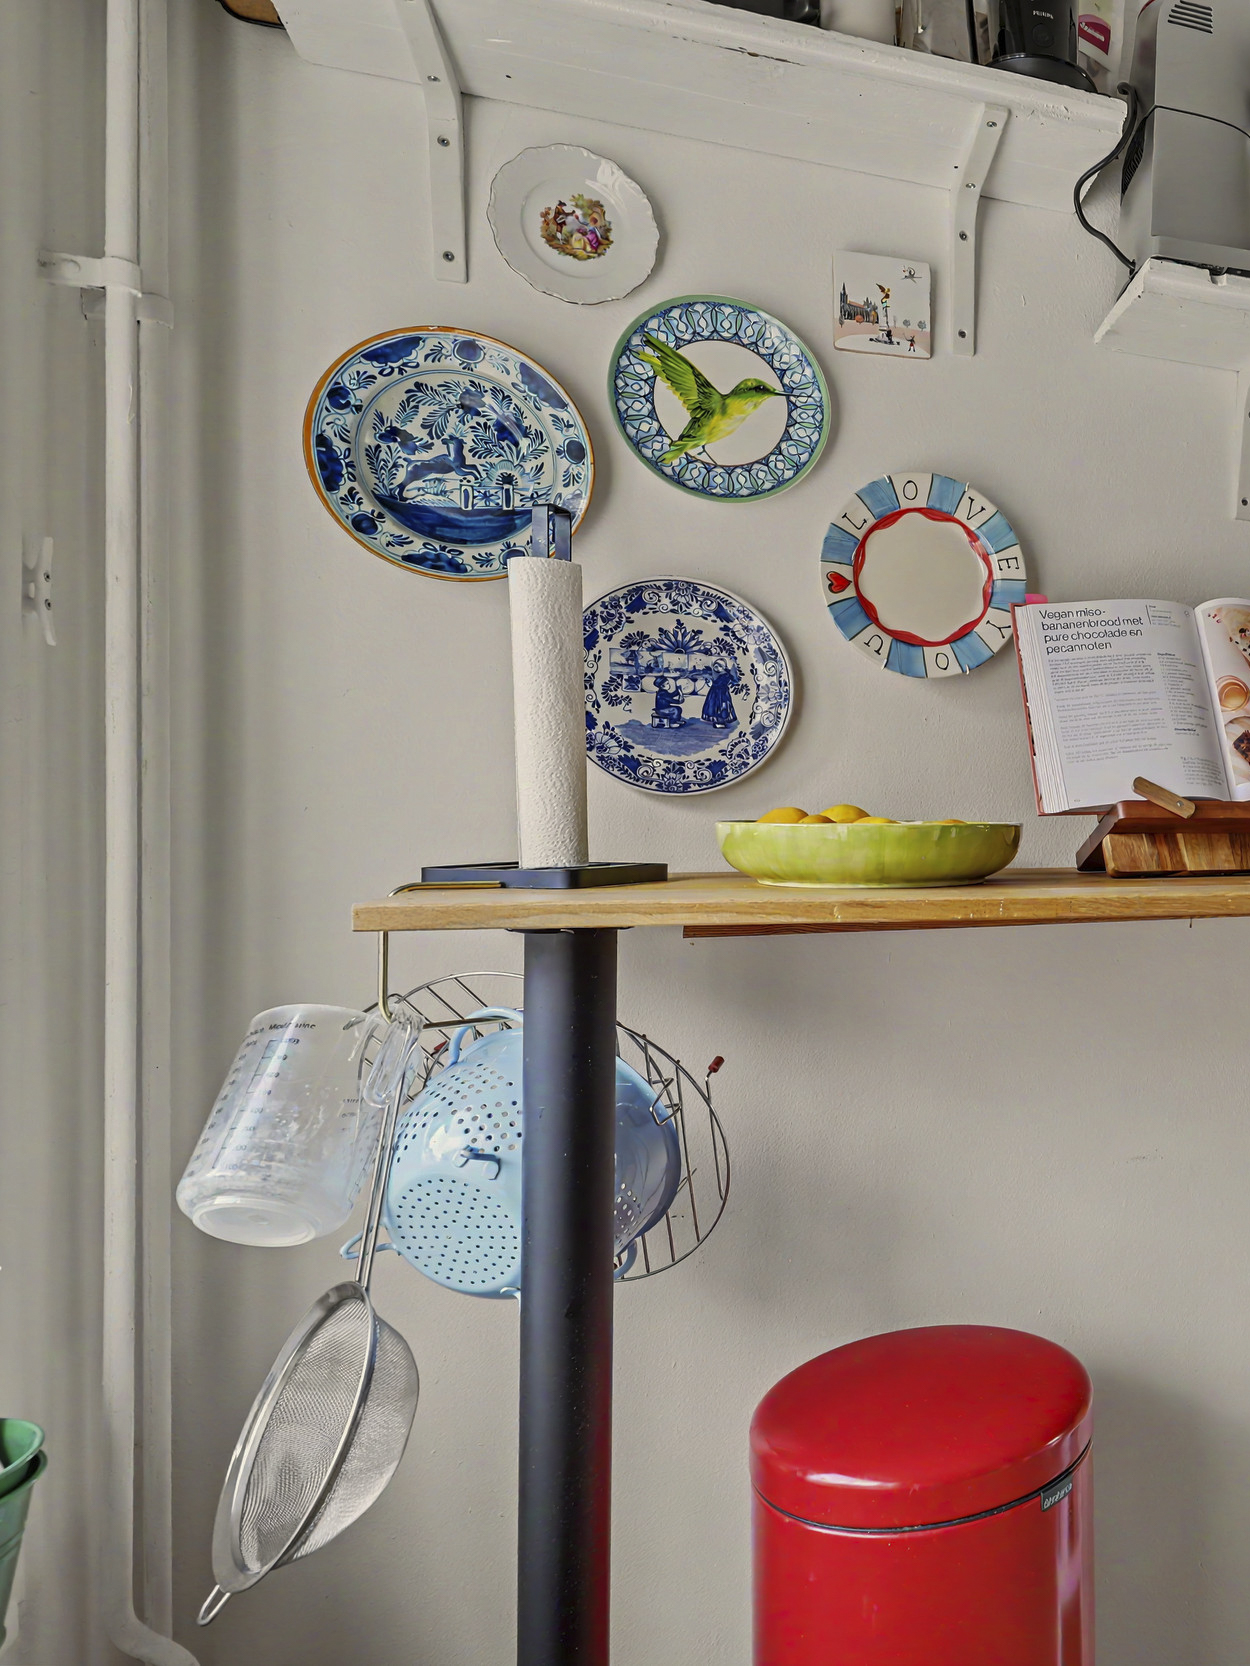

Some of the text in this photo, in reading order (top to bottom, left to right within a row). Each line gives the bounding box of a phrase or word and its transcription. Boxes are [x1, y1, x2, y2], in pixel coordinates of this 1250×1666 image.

[1038, 607, 1106, 621] Vegan miso-
[1041, 616, 1121, 631] bananenbrood
[1122, 616, 1144, 626] met
[1043, 628, 1143, 644] pure chocolade en
[1046, 641, 1112, 655] pecannoten
